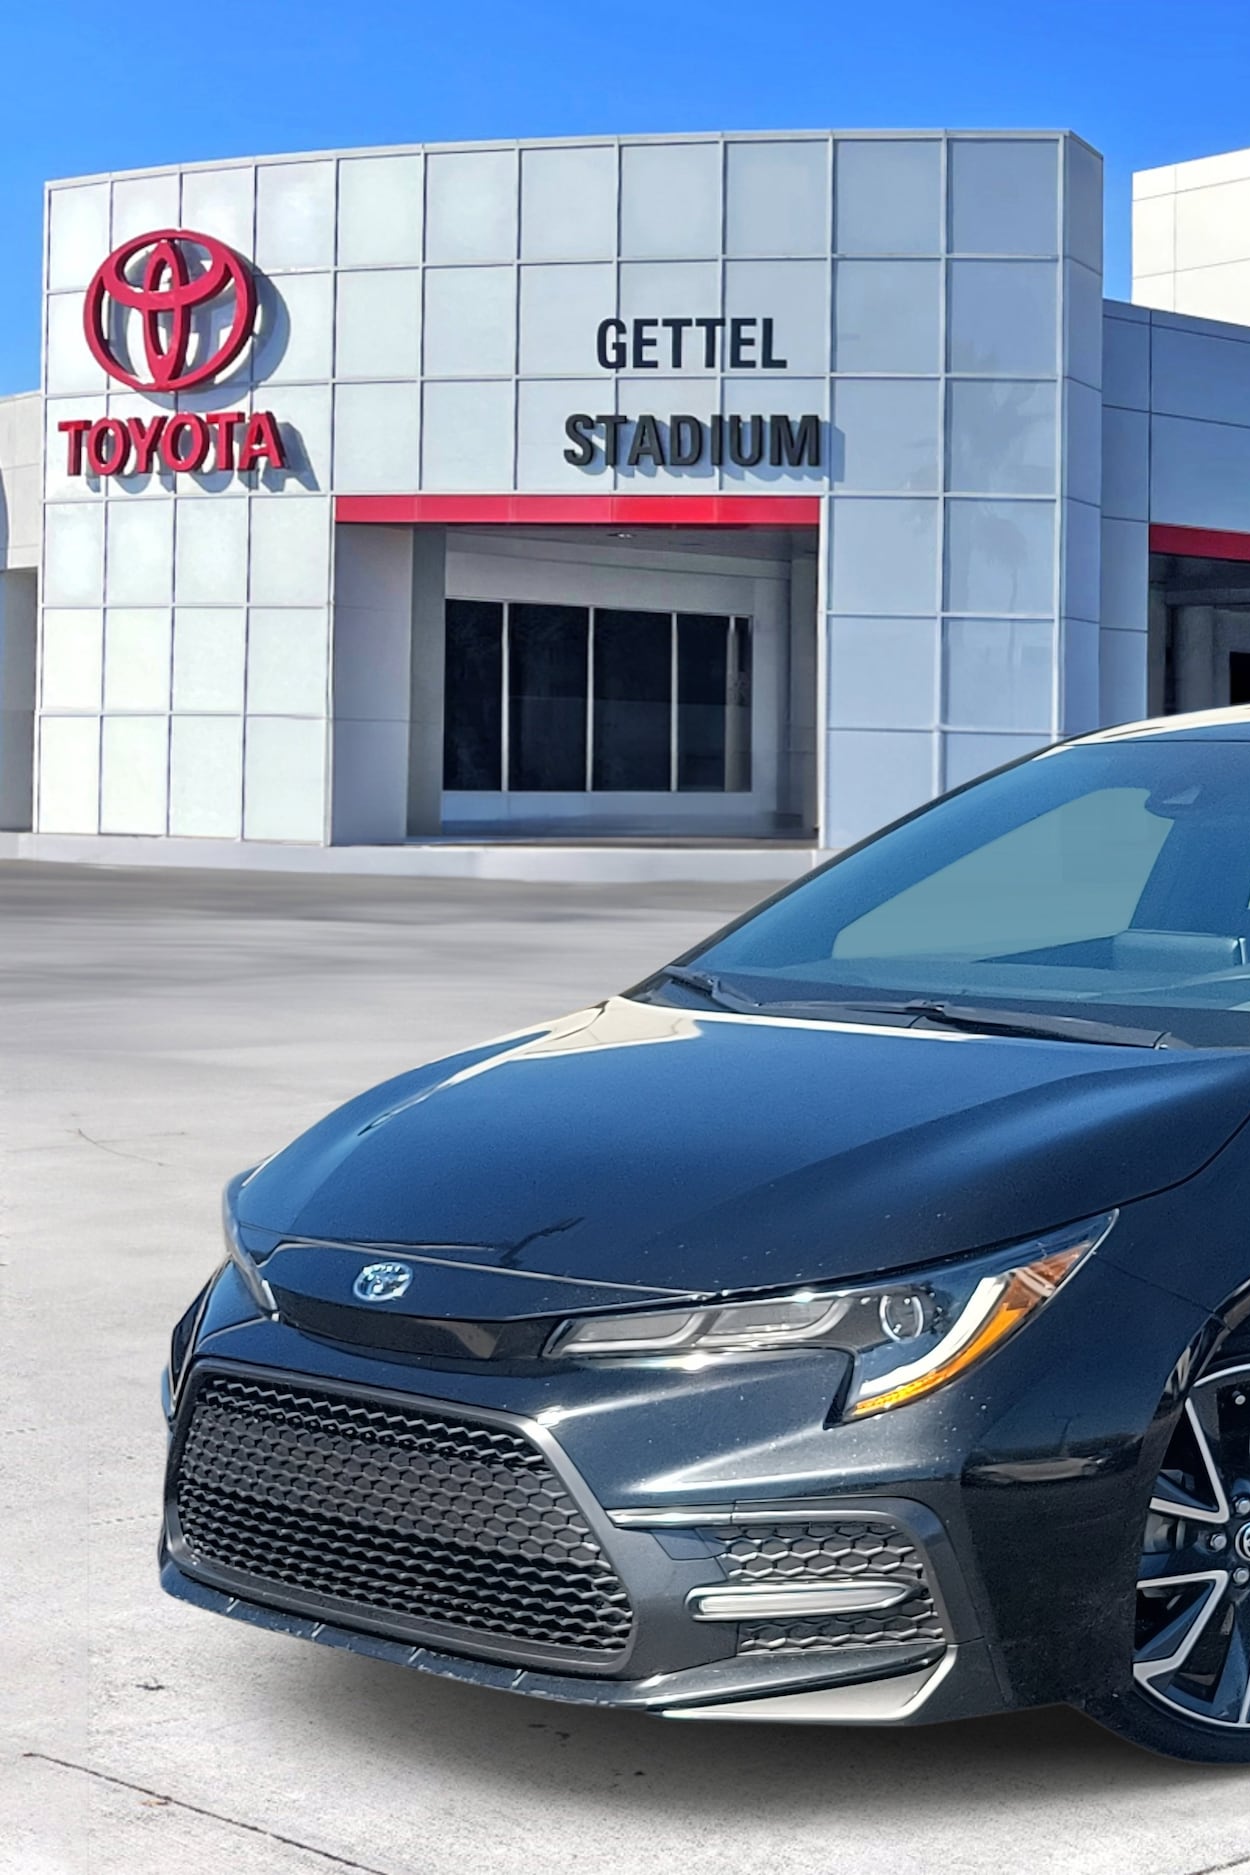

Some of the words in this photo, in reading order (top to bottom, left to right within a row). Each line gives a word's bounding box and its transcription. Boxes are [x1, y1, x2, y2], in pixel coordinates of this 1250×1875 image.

[596, 317, 788, 369] GETTEL
[57, 410, 287, 477] TOYOTA
[563, 413, 821, 467] STADIUM
